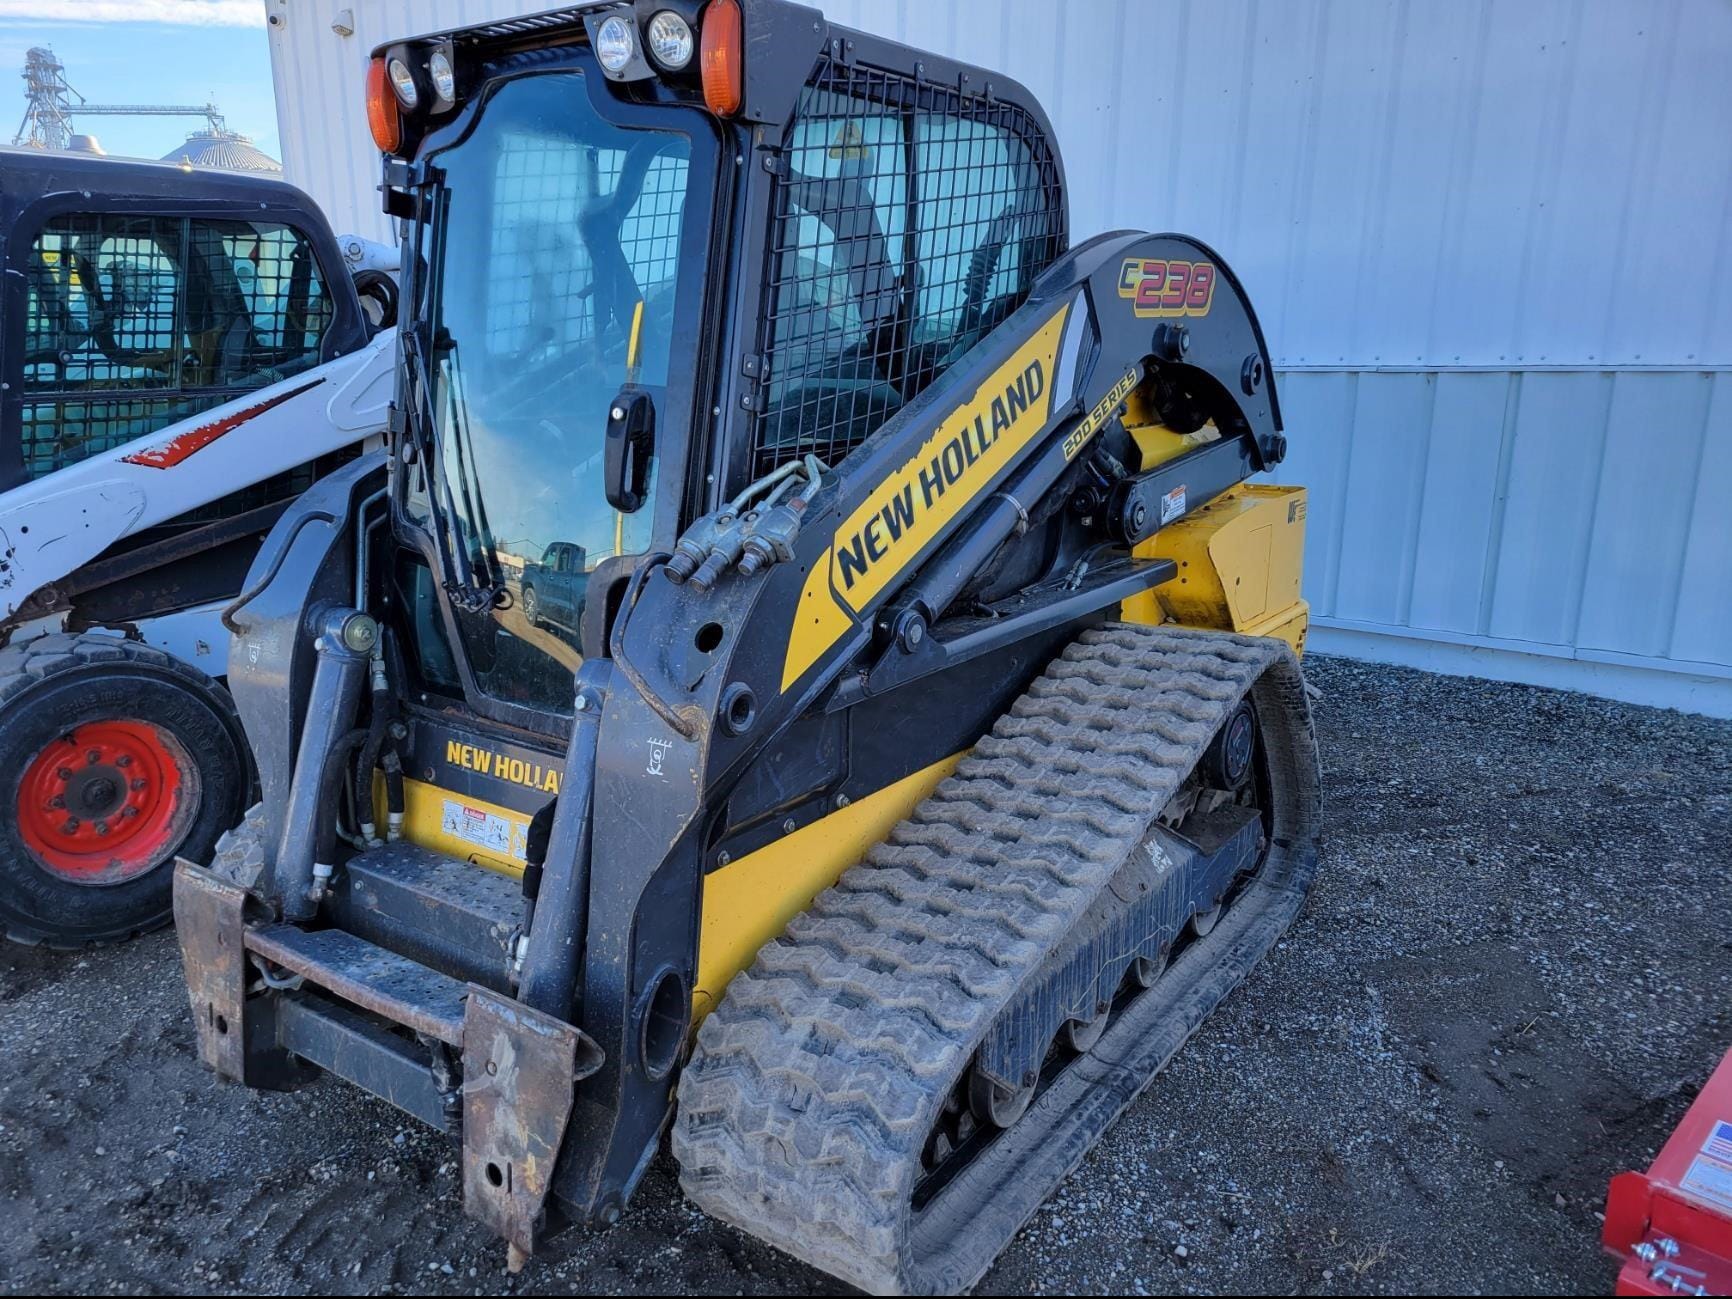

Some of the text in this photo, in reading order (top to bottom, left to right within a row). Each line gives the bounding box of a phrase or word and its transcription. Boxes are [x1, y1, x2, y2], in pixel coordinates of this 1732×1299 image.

[1119, 259, 1215, 314] C238
[1063, 371, 1136, 457] 200 SERIES
[837, 358, 1044, 591] NEW HOLLAND
[446, 740, 564, 795] NEW HOLLA
